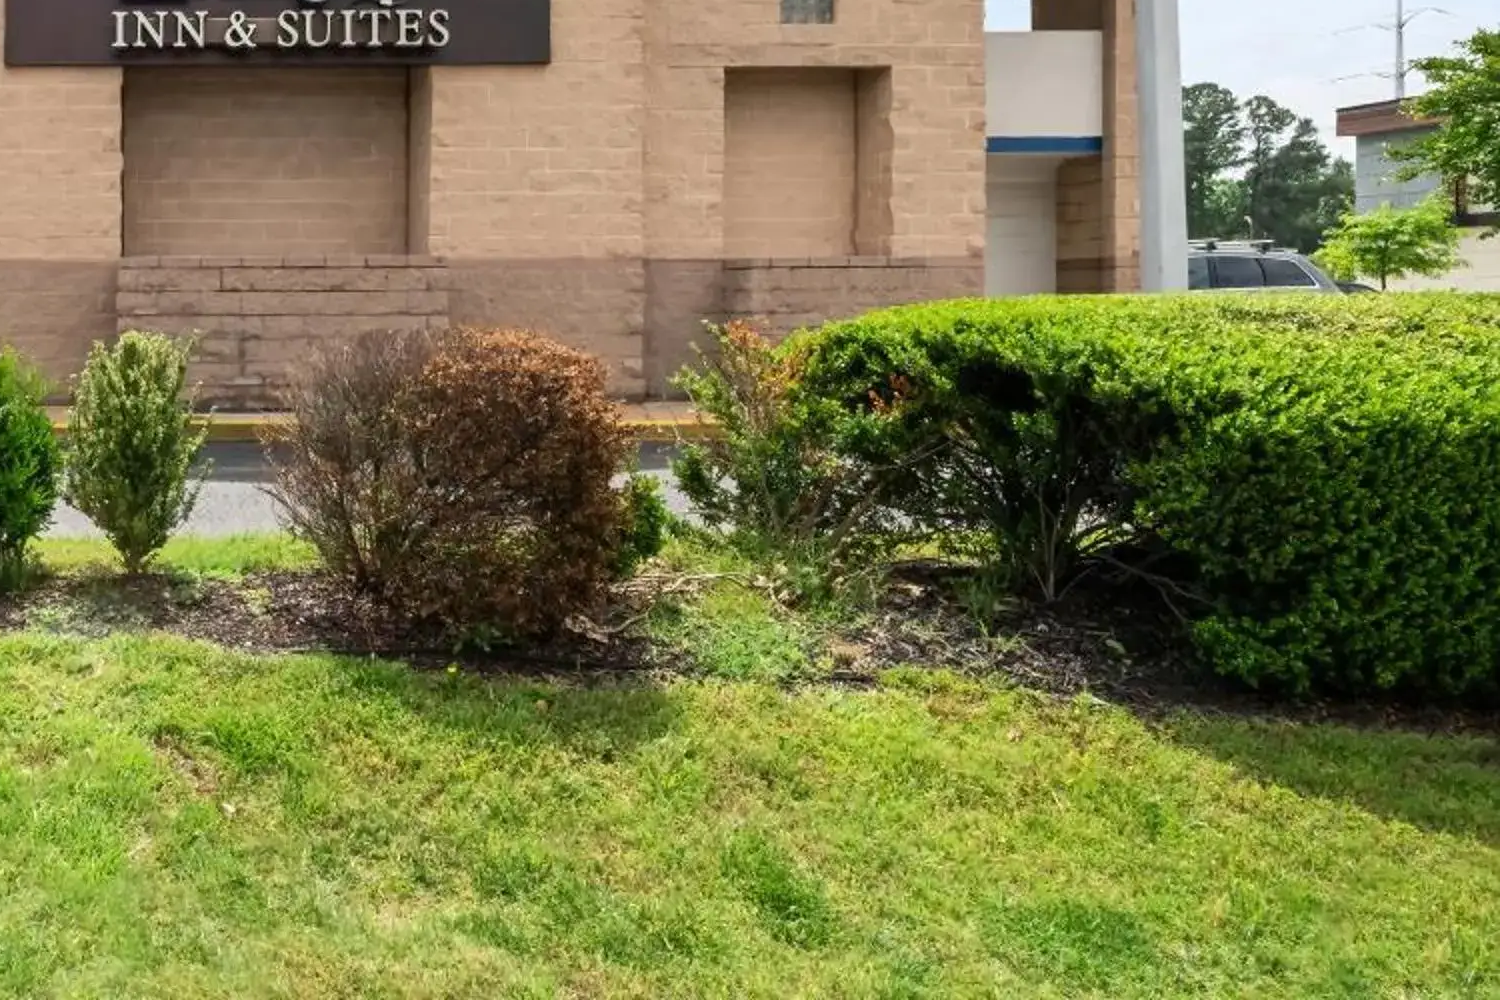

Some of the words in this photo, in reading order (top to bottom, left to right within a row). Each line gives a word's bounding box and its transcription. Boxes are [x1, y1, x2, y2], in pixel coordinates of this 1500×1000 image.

[111, 10, 209, 48] INN
[224, 10, 257, 48] &
[277, 9, 450, 48] SUITES
